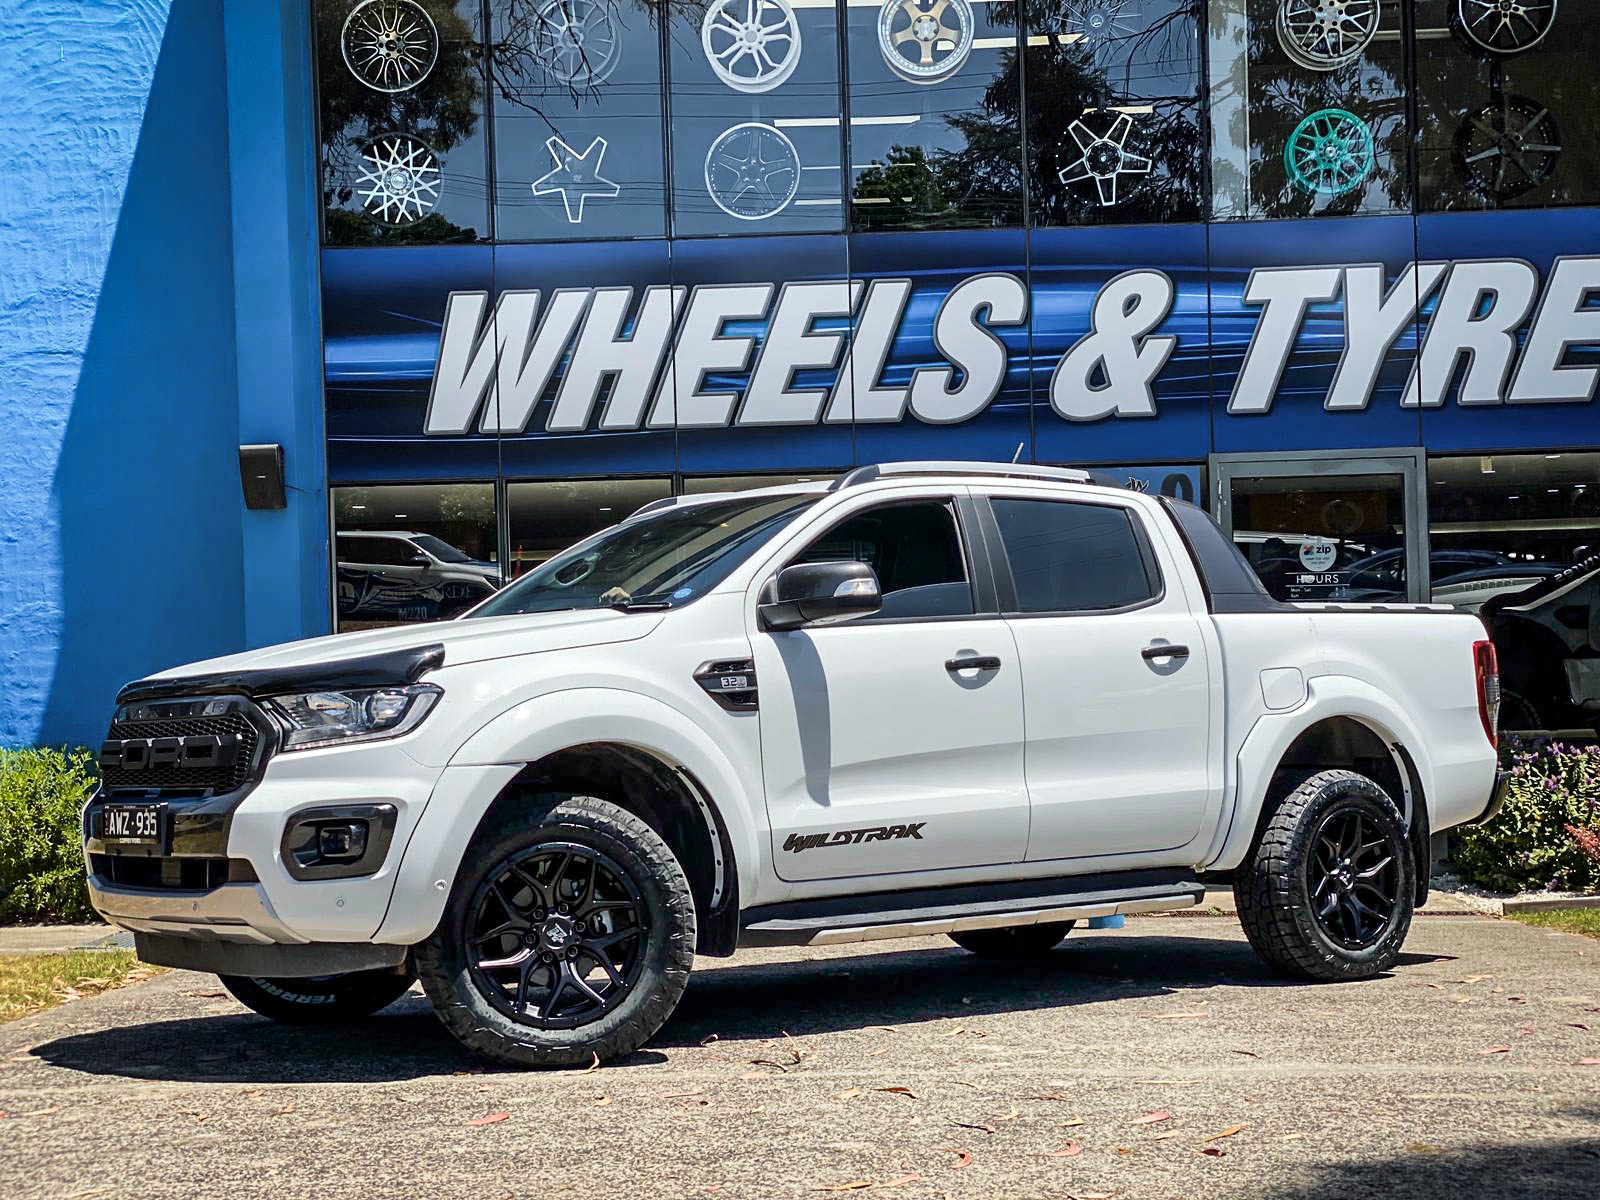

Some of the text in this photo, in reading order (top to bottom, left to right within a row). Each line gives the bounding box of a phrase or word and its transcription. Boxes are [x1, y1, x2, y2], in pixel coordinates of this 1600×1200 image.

[423, 254, 1600, 435] WHEELS & TYRE
[1316, 544, 1332, 555] zip
[1296, 574, 1340, 584] HOURS
[783, 822, 927, 853] WILDTRAK
